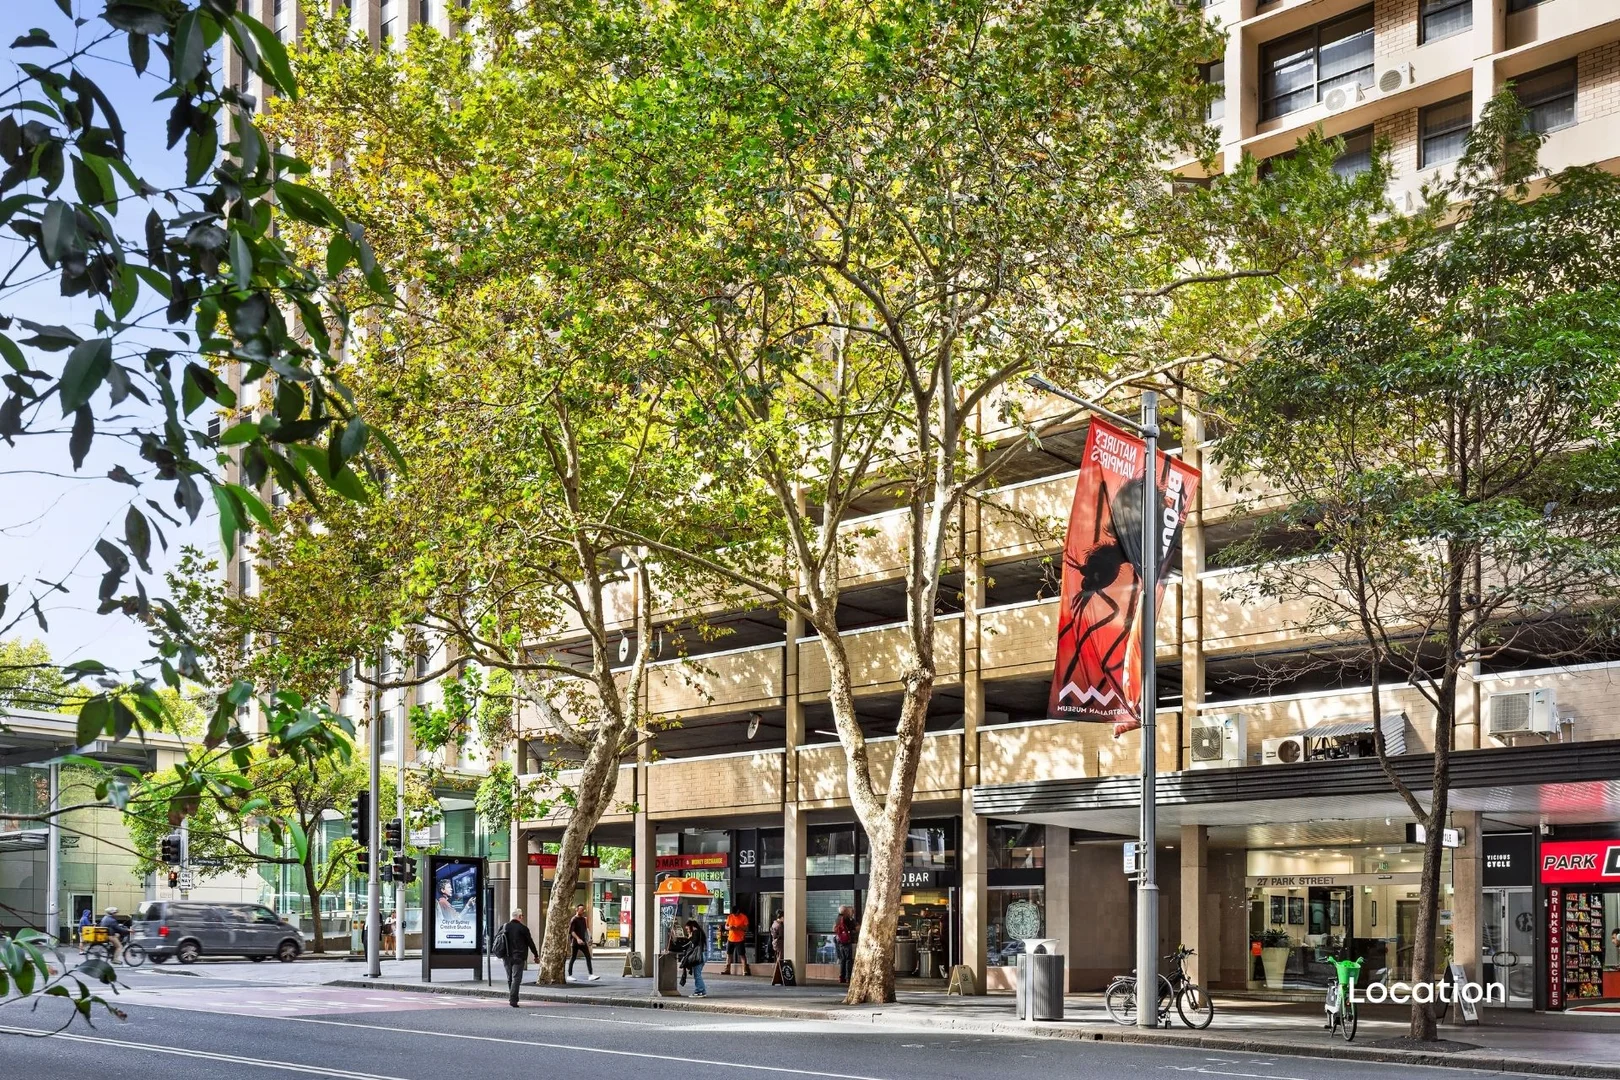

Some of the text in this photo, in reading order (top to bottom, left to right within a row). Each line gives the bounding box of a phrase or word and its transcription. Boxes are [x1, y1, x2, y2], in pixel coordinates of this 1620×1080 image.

[662, 858, 684, 868] MART
[740, 850, 755, 864] SB
[1543, 854, 1598, 870] PARK
[685, 871, 725, 881] CURRENCY
[909, 872, 929, 883] BAR
[1257, 876, 1336, 886] 27 PARK STREET
[1551, 890, 1559, 934] DRINKS
[1550, 947, 1559, 1006] MUNCHIES
